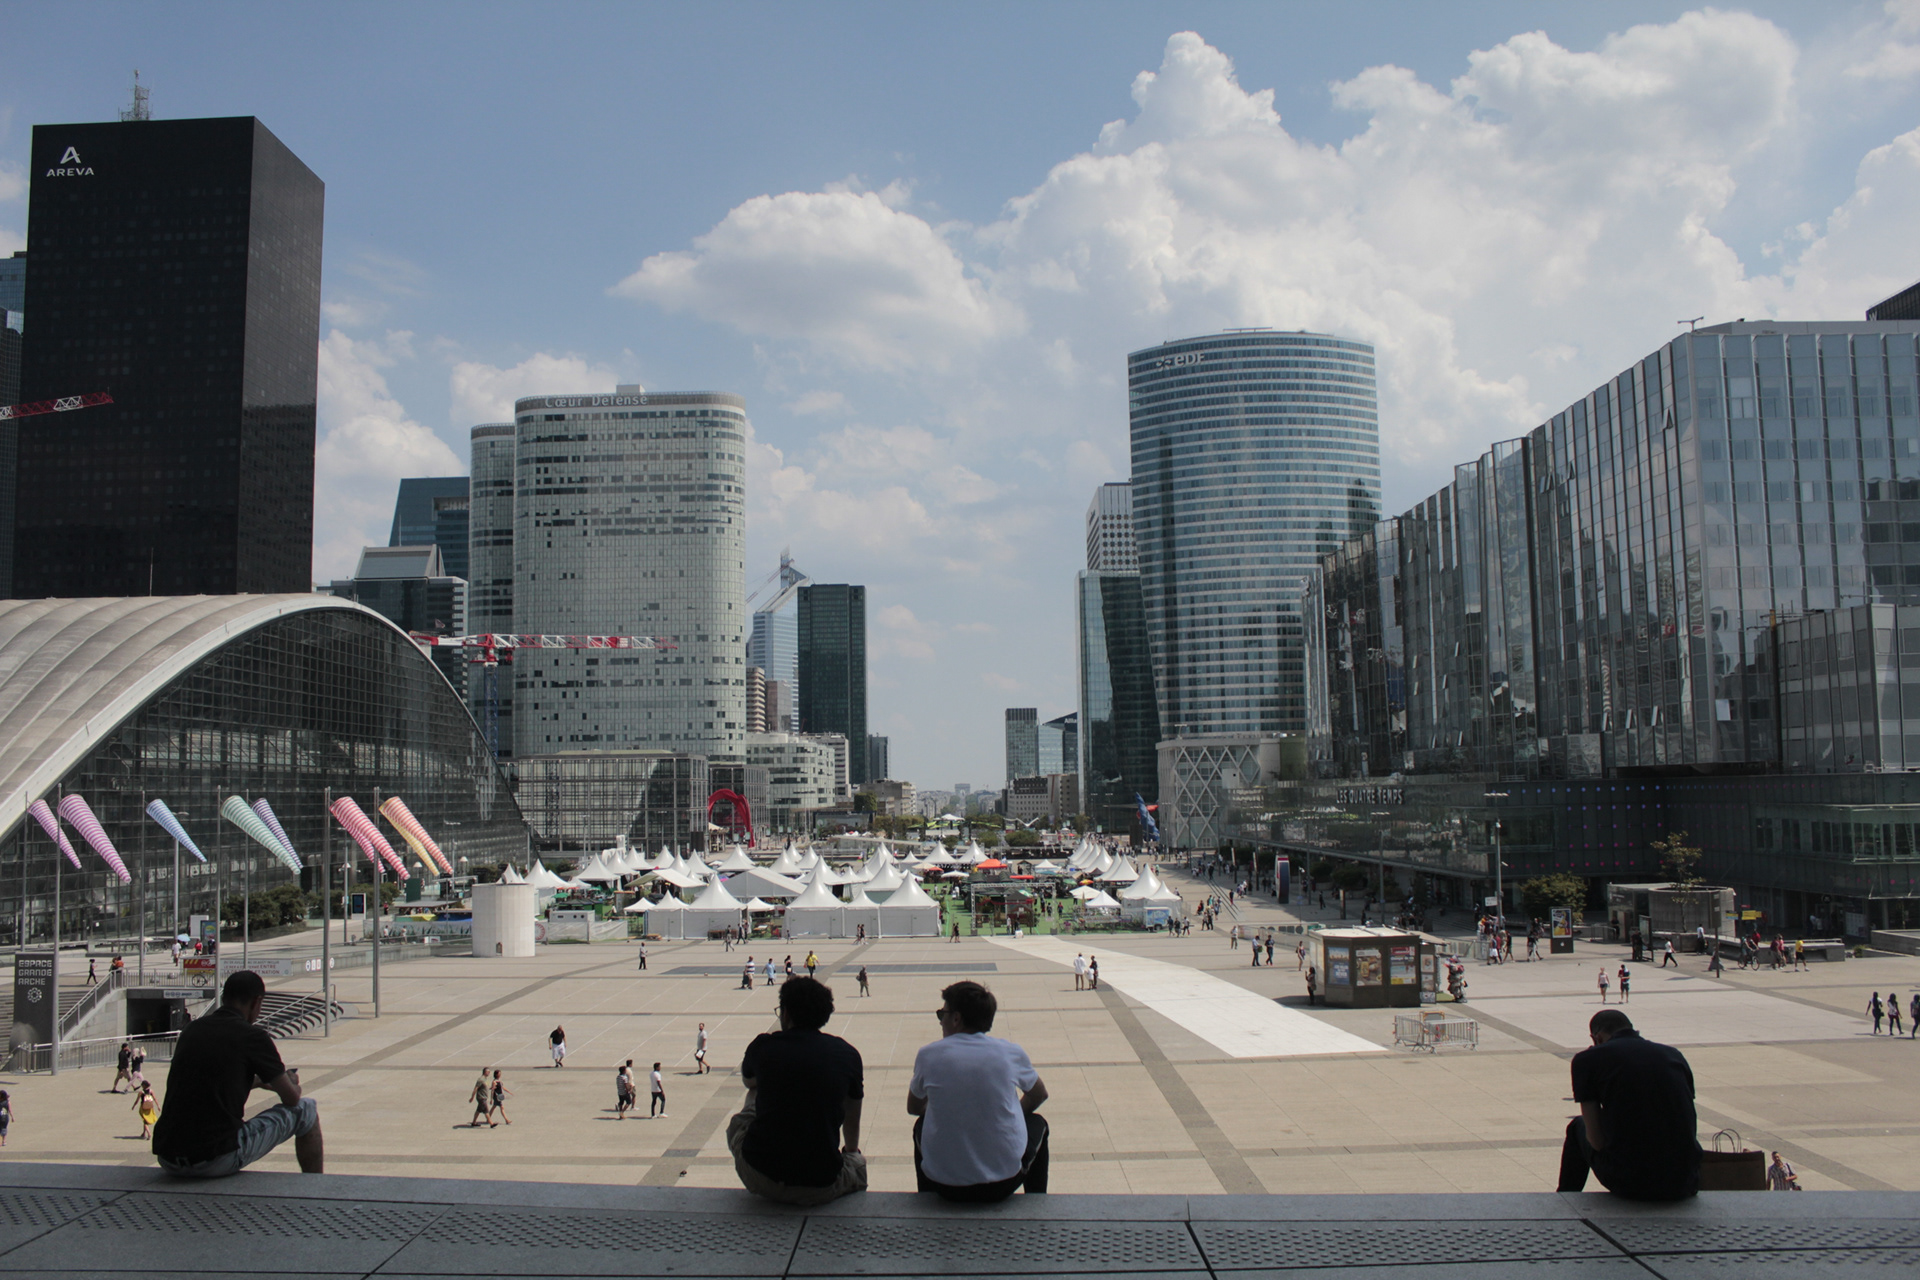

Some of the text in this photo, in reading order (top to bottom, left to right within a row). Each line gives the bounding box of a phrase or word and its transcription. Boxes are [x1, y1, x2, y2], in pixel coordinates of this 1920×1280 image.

[46, 167, 95, 177] AREVA
[1336, 788, 1404, 805] LES QUATRE TEMPS
[18, 959, 53, 968] ESPACE
[18, 968, 53, 977] GRANDE
[18, 977, 46, 986] ARCHE
